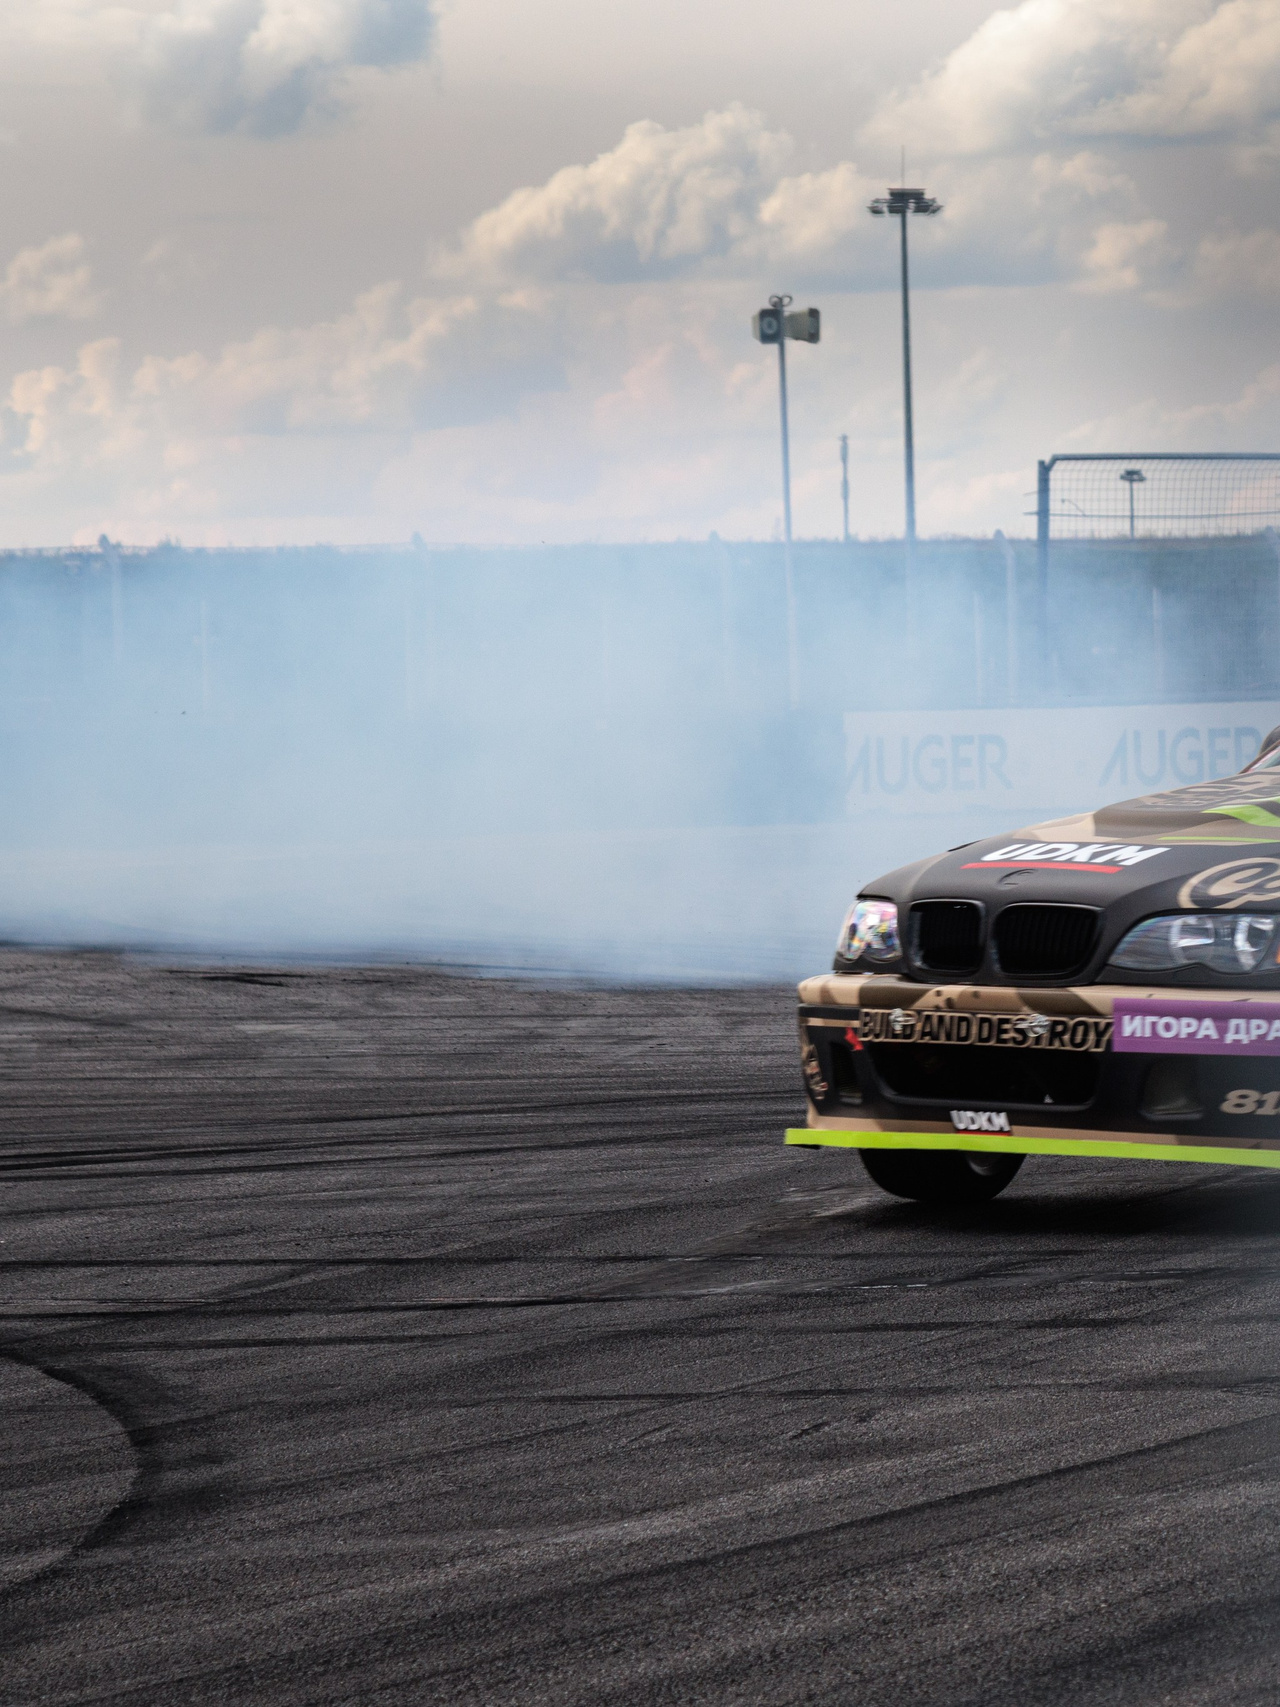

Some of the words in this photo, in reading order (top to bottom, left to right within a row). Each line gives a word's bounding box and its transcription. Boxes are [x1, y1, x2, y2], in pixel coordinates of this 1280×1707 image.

[845, 733, 1014, 794] AUGER
[980, 842, 1171, 867] UDKM
[1121, 1014, 1217, 1040] ИГОРА
[950, 1110, 1011, 1132] UDKM
